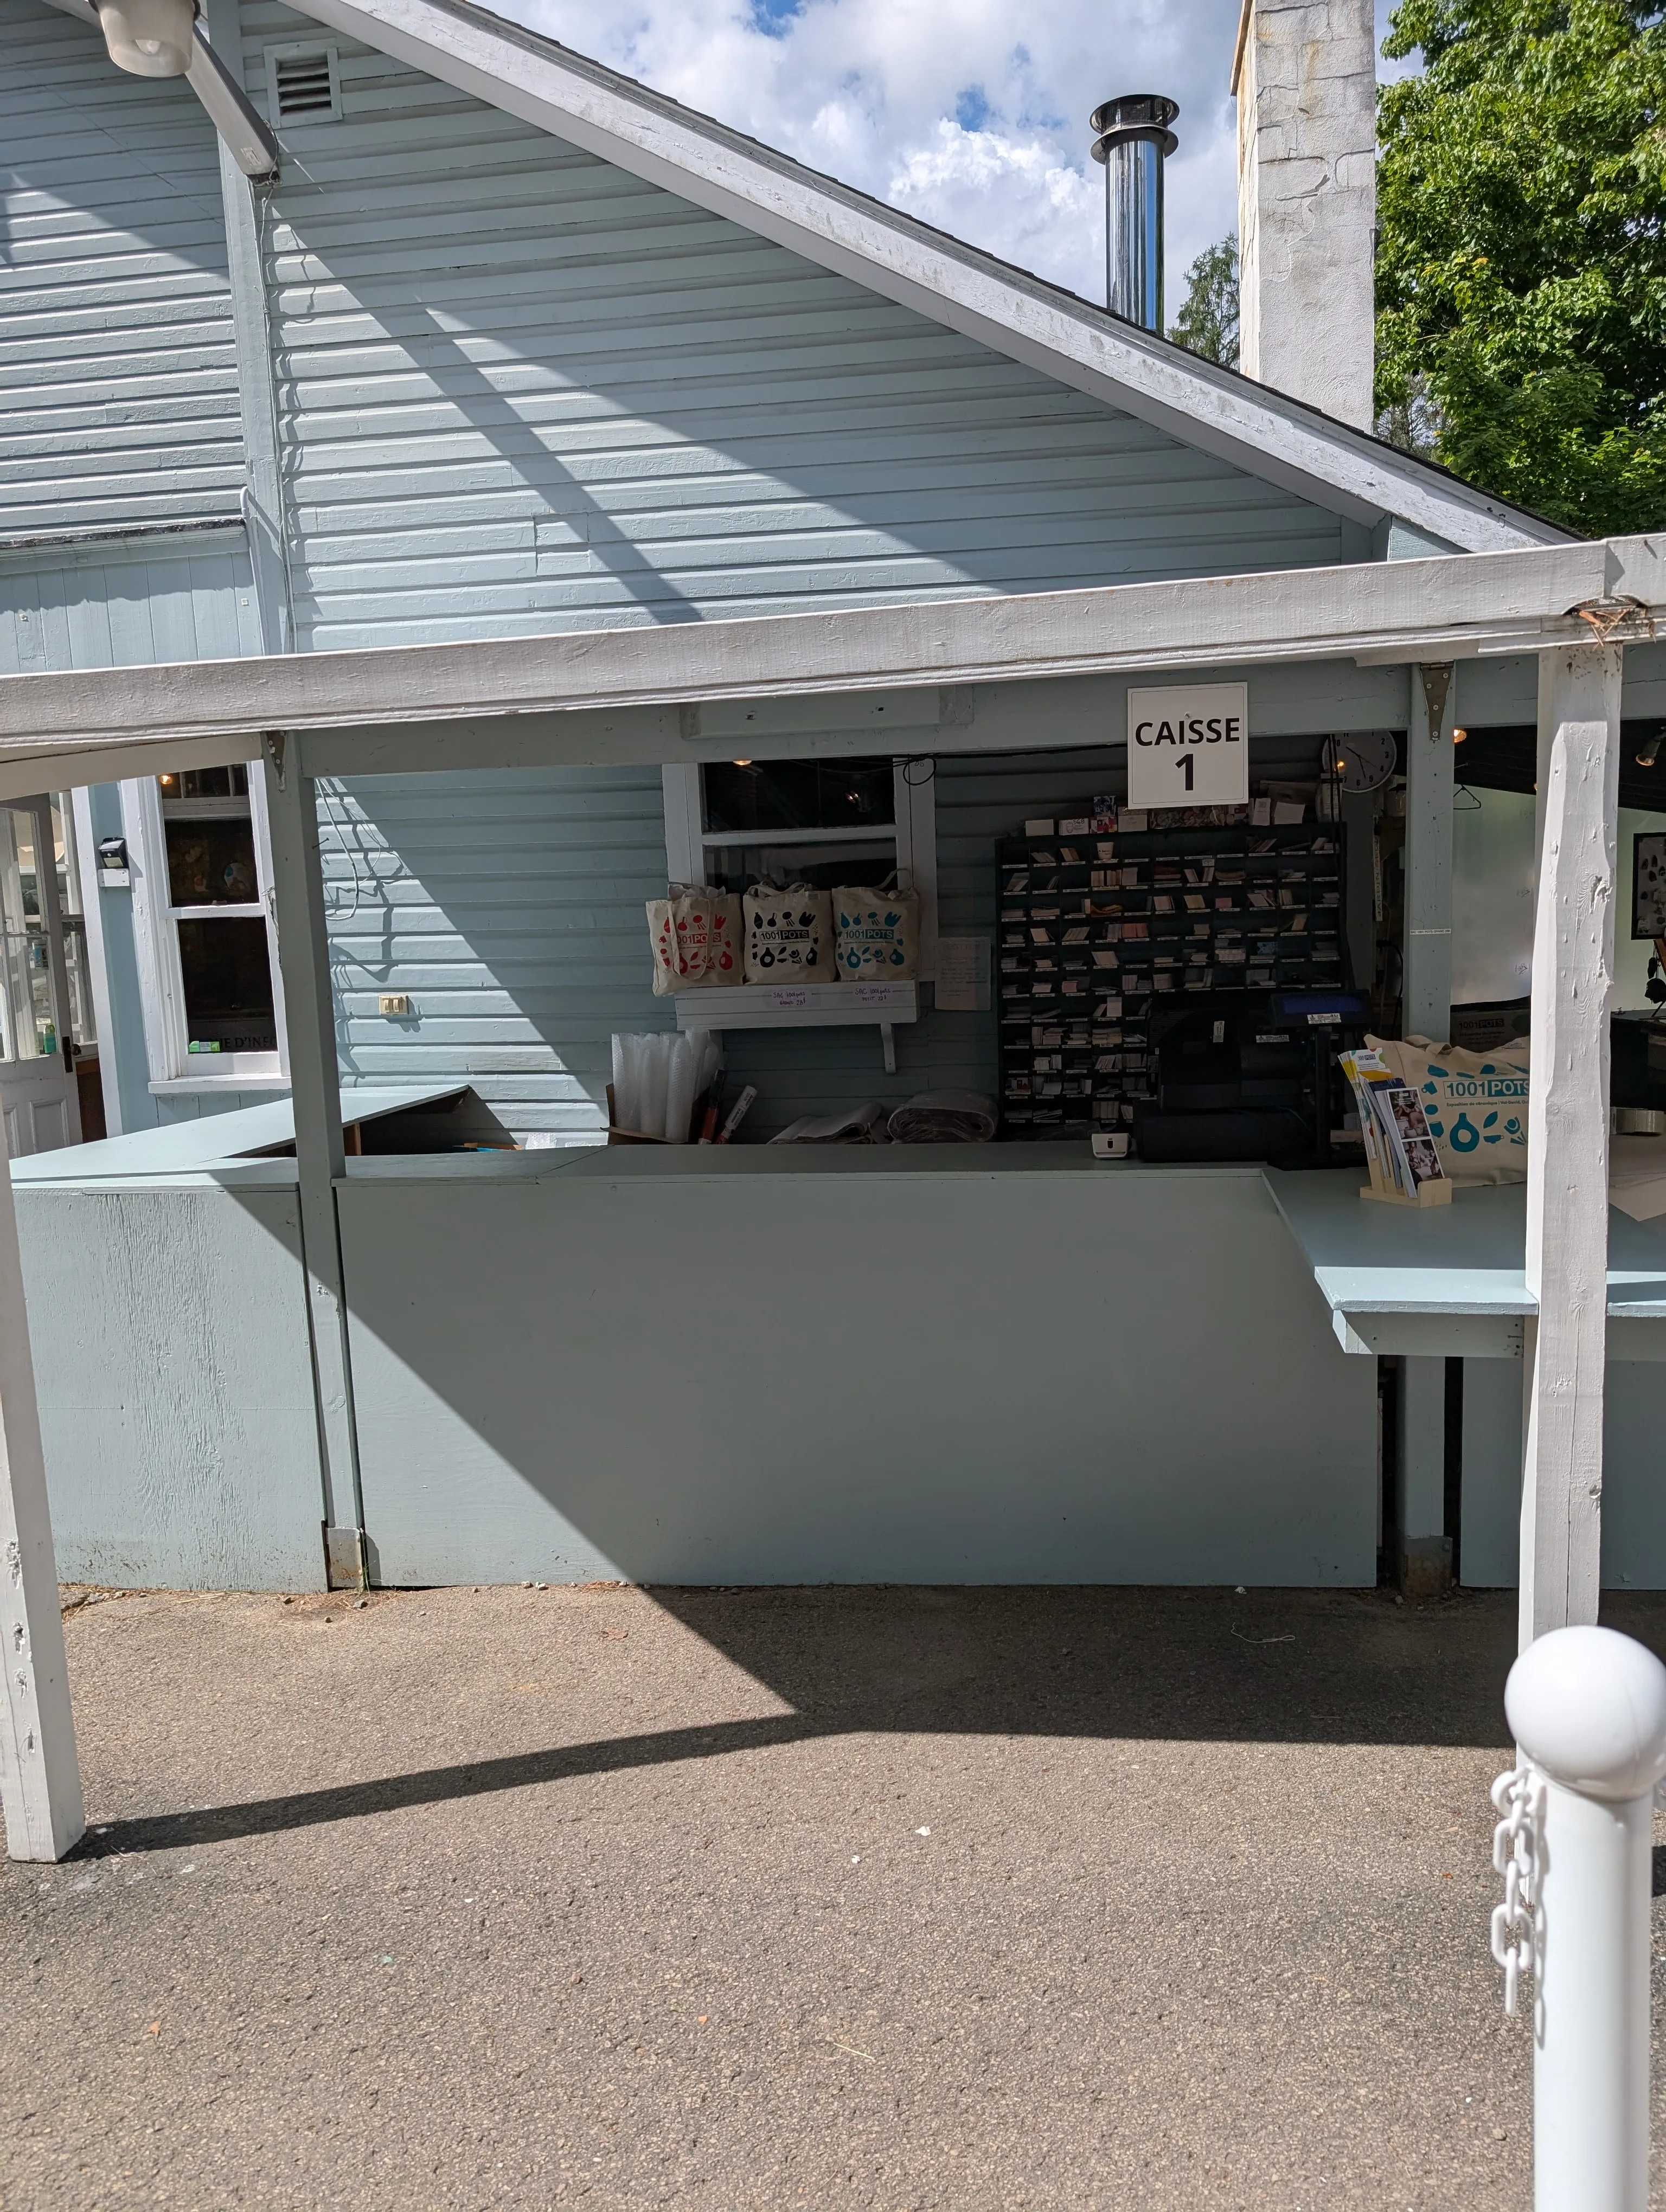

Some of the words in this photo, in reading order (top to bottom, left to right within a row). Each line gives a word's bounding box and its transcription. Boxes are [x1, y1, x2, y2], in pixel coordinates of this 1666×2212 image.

[1135, 717, 1240, 747] CAISSE
[1175, 753, 1194, 791] 1
[694, 933, 720, 944] POS
[1447, 1082, 1485, 1097] 1001
